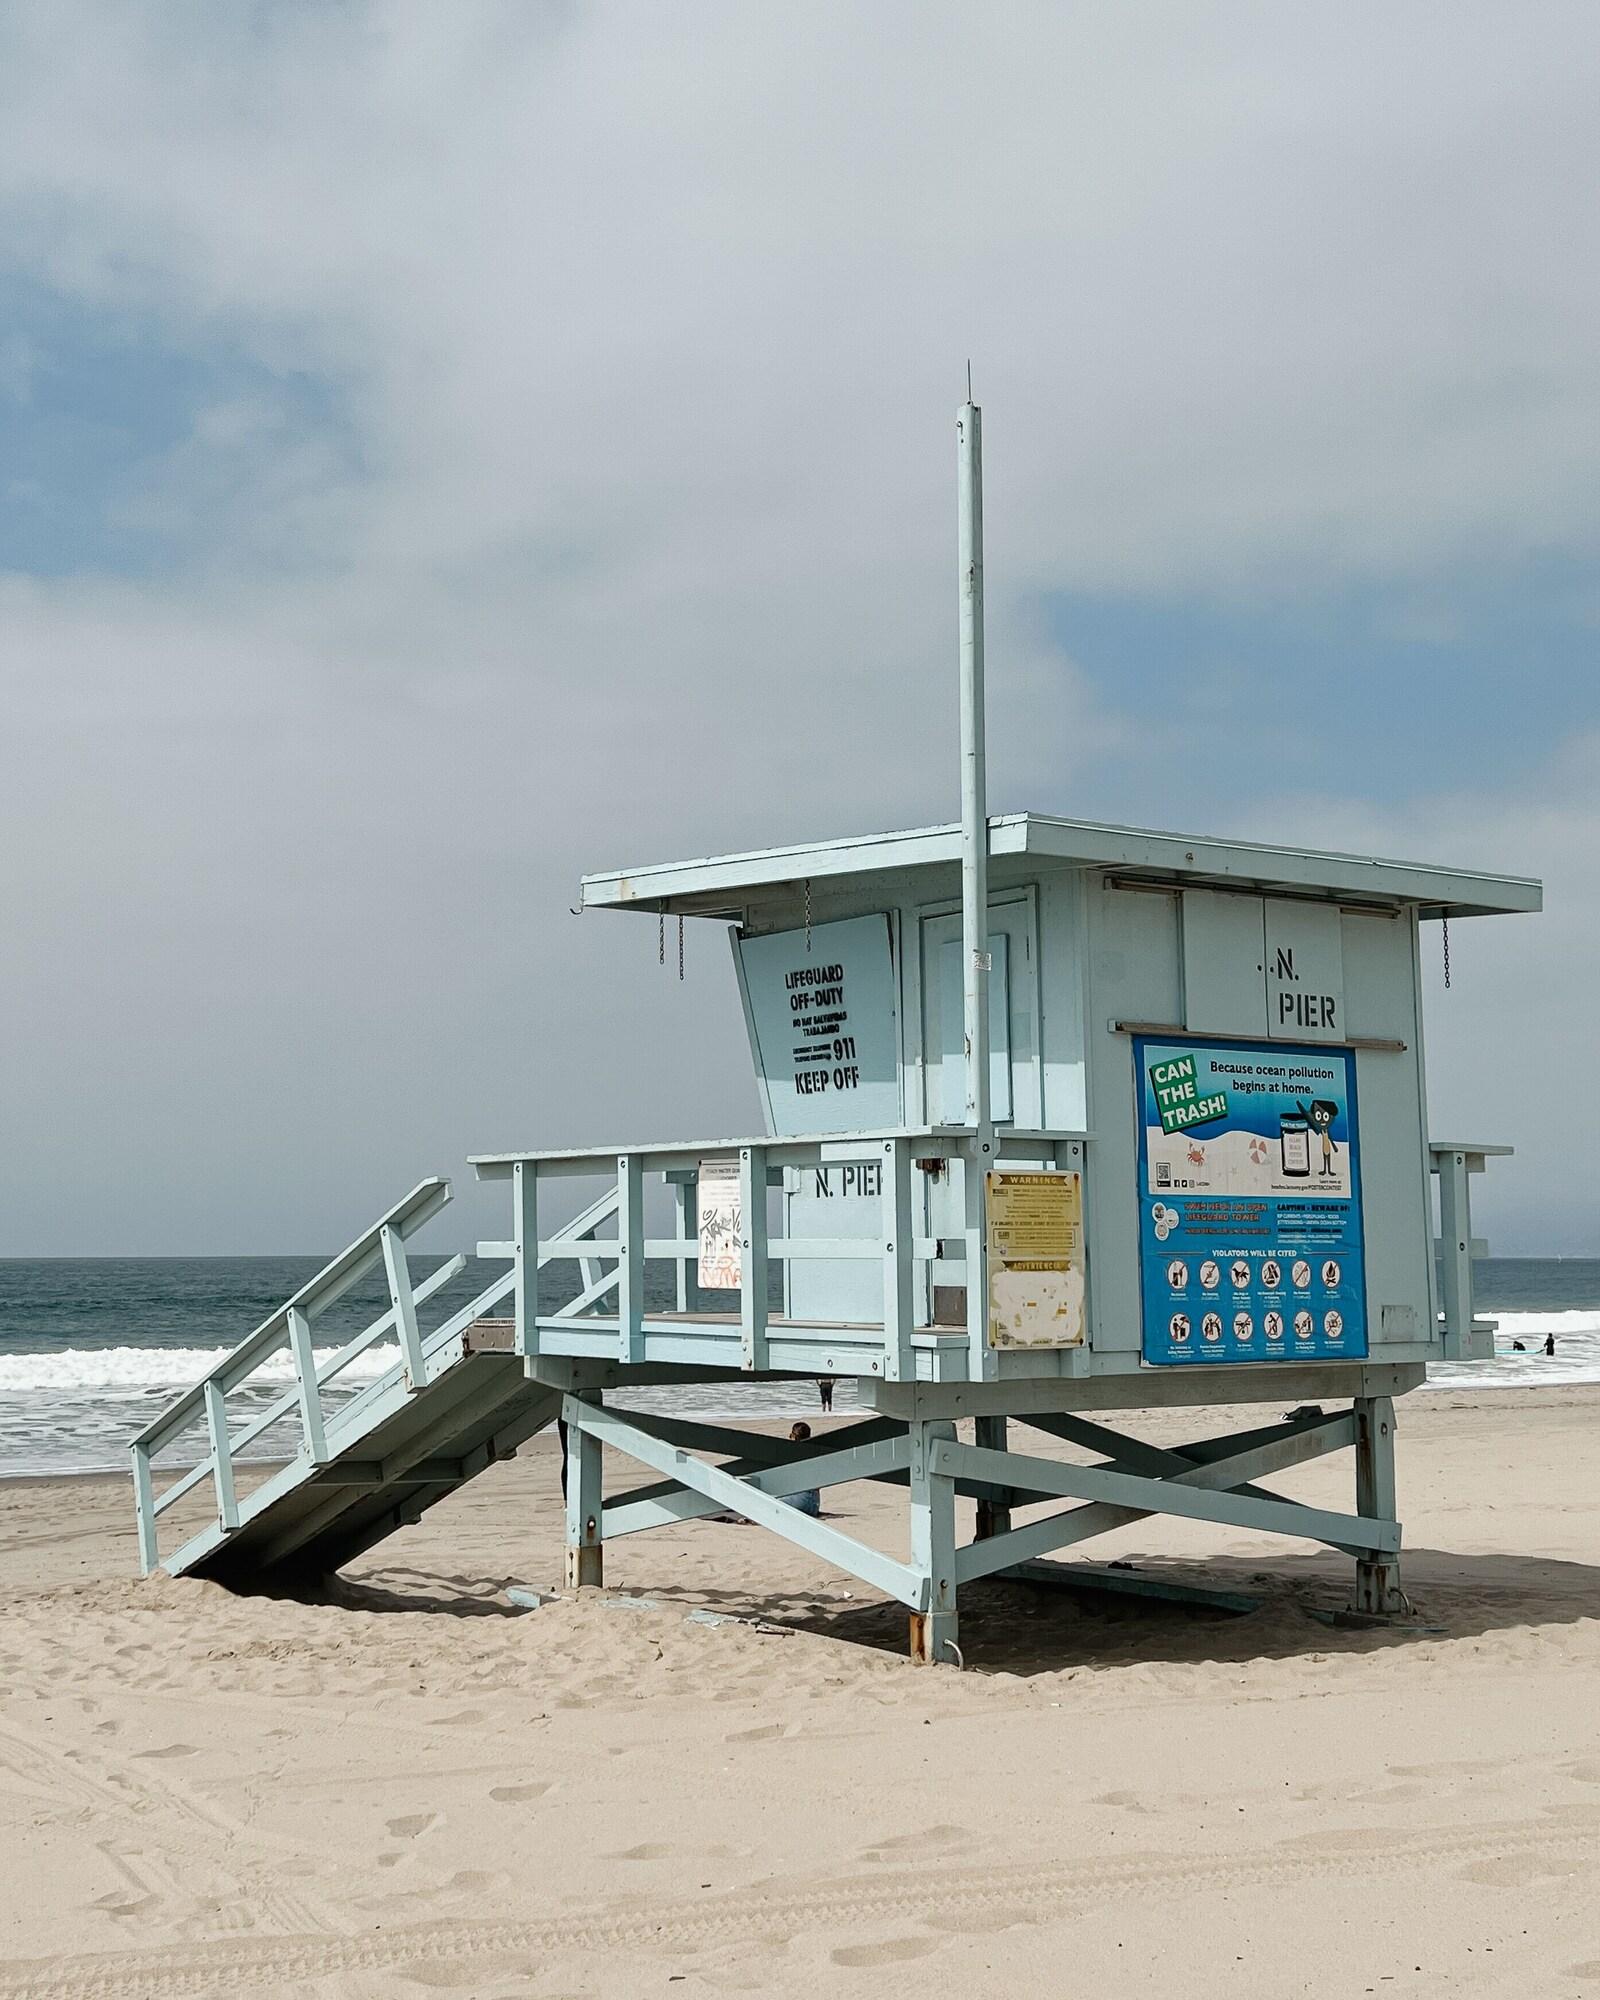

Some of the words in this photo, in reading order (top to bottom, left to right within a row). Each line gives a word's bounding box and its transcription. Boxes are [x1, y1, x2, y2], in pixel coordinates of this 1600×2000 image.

[1277, 947, 1299, 980] N.
[785, 964, 844, 989] LIFEGUARD
[790, 986, 843, 1011] OFF-DUTY
[1279, 992, 1335, 1028] PIER
[833, 1037, 856, 1060] 911
[795, 1070, 829, 1094] KEEP
[833, 1066, 859, 1090] OFF
[1155, 1059, 1193, 1083] CAN
[1210, 1061, 1253, 1074] Because
[1256, 1065, 1286, 1076] ocean
[1288, 1066, 1334, 1079] pollution
[1159, 1081, 1195, 1105] THE
[1232, 1079, 1266, 1094] begins
[1269, 1082, 1279, 1093] at
[1282, 1083, 1314, 1094] home.
[1163, 1095, 1226, 1127] TRASH!
[816, 1167, 834, 1198] N.
[1009, 1176, 1057, 1185] WARNING
[1185, 1213, 1229, 1221] LIFEGUARD
[1231, 1213, 1259, 1221] TOWER
[1212, 1249, 1248, 1257] VIOLATORS
